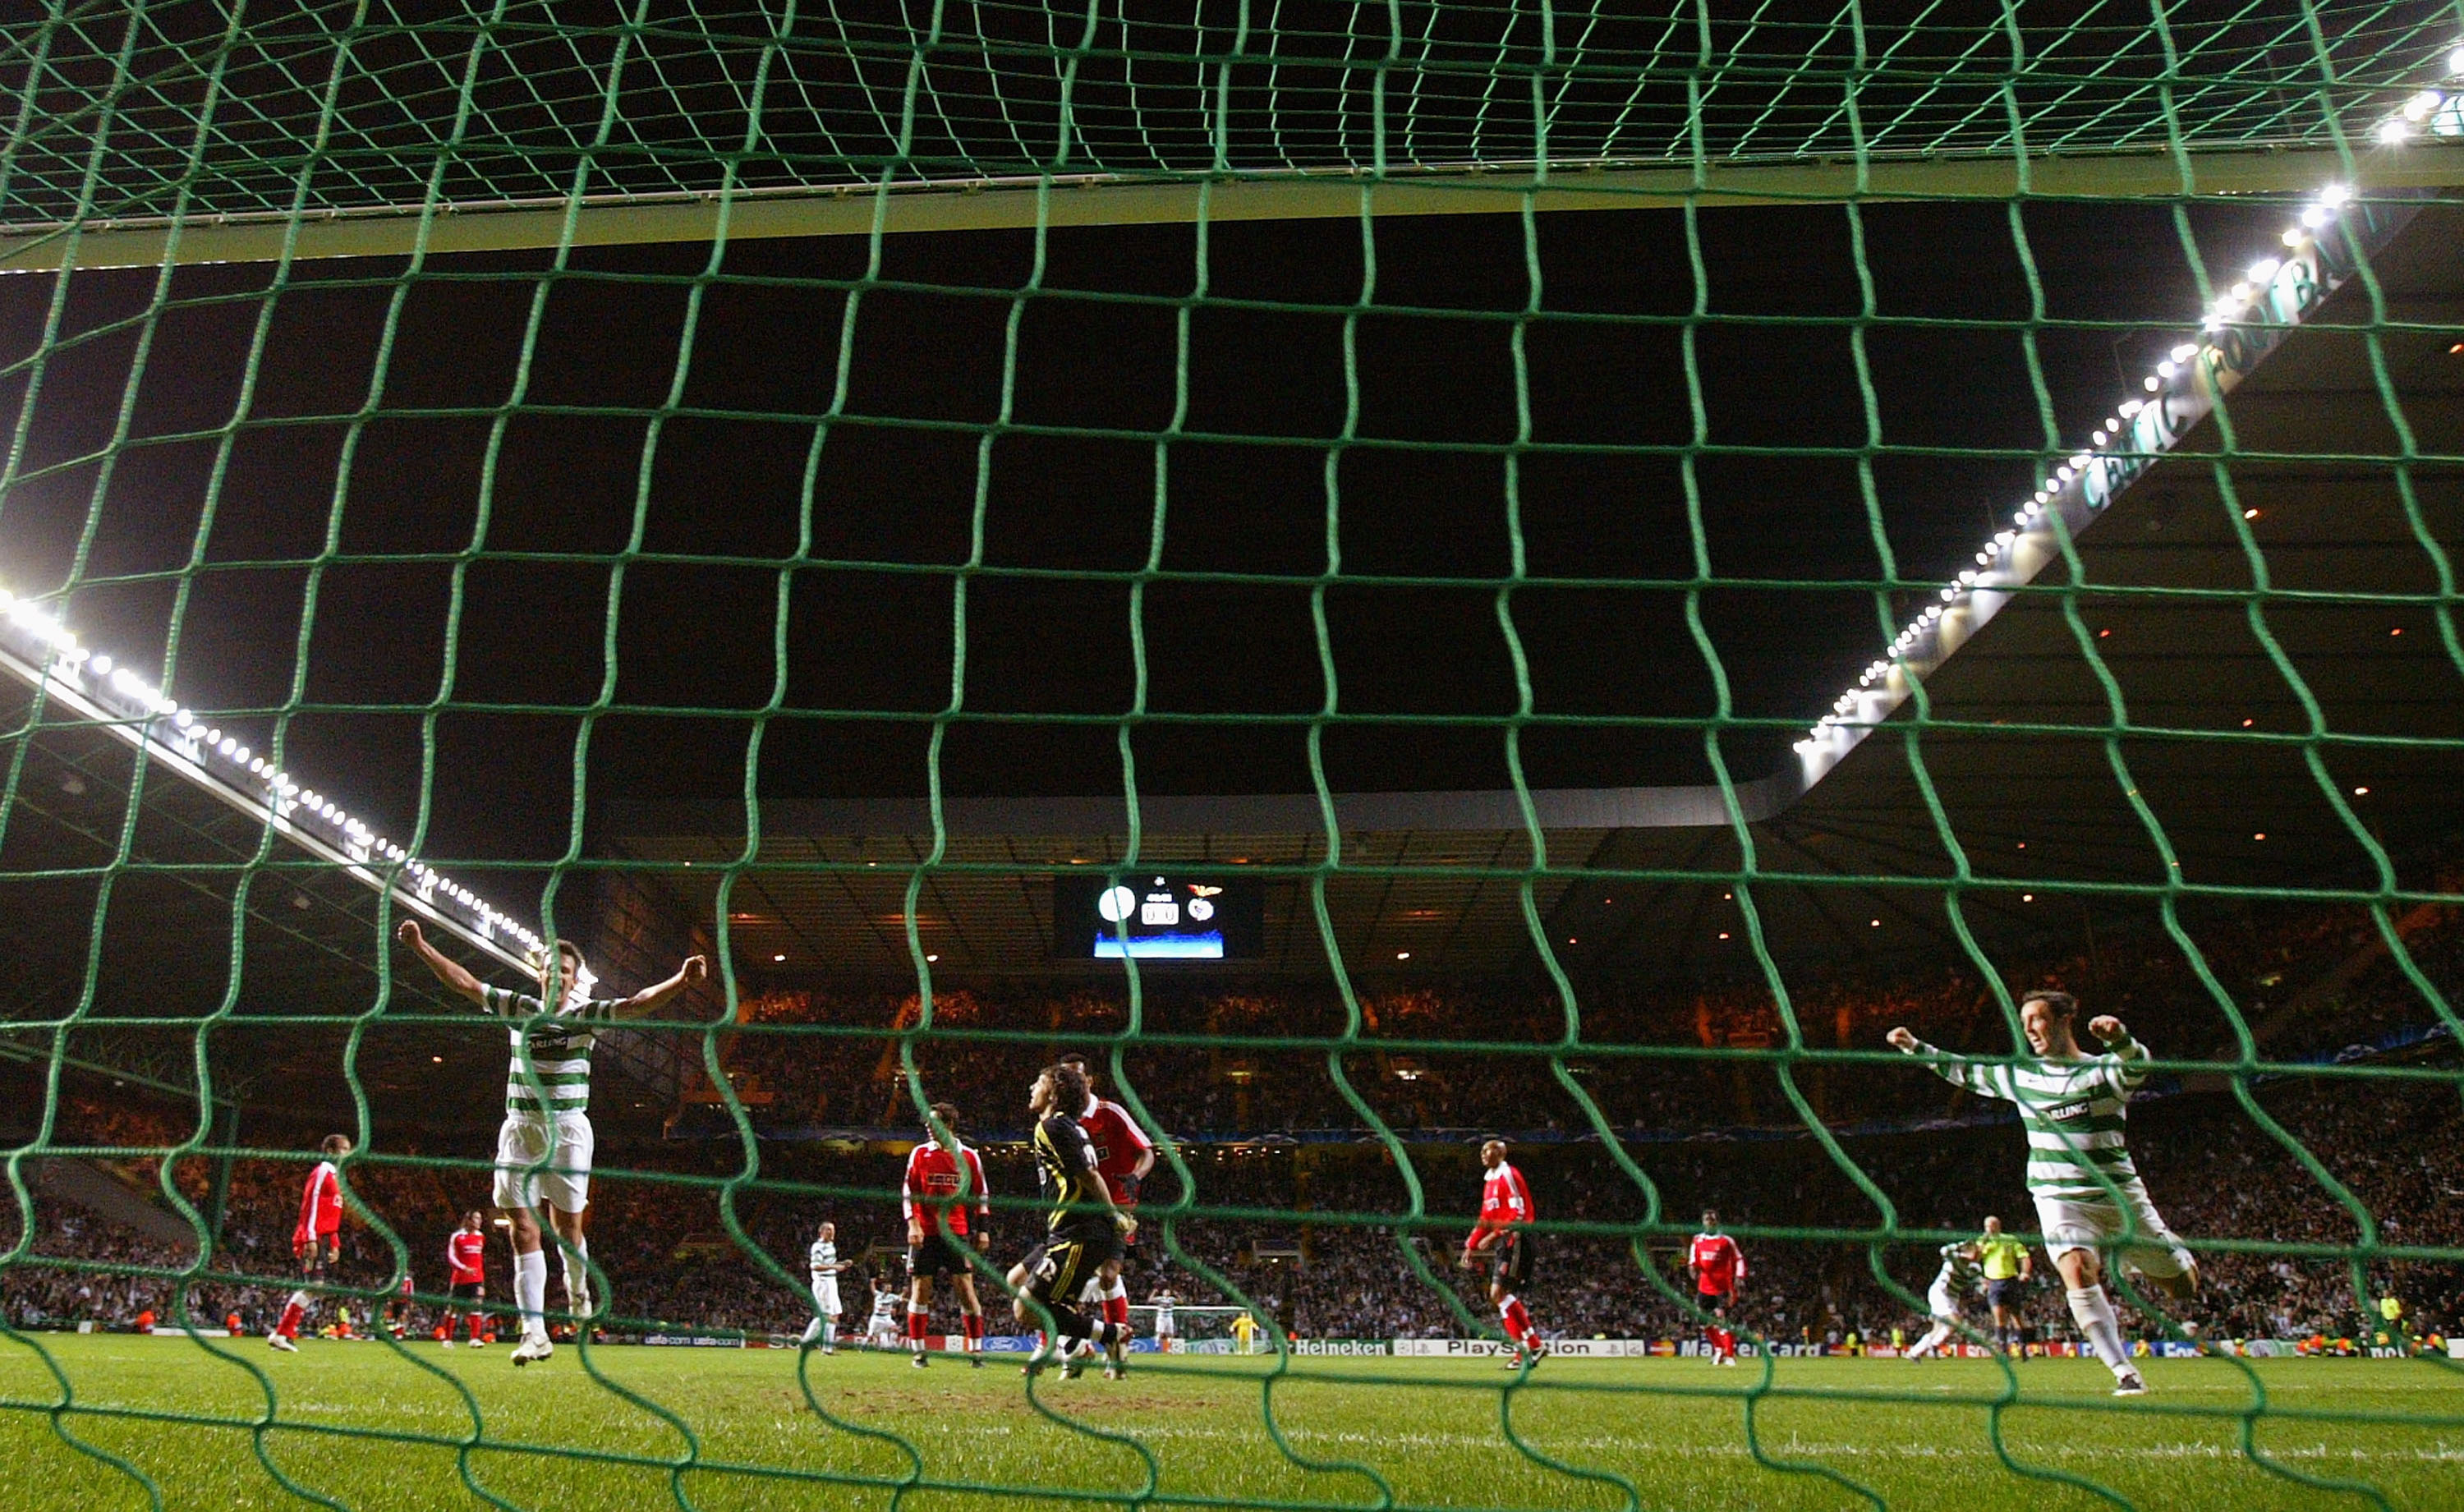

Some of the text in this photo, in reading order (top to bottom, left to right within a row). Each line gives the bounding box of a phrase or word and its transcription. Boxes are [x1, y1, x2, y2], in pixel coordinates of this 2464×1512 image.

[1295, 1339, 1387, 1356] Heineken
[1447, 1340, 1590, 1357] PlayStion
[1680, 1340, 1821, 1357] MaerCard
